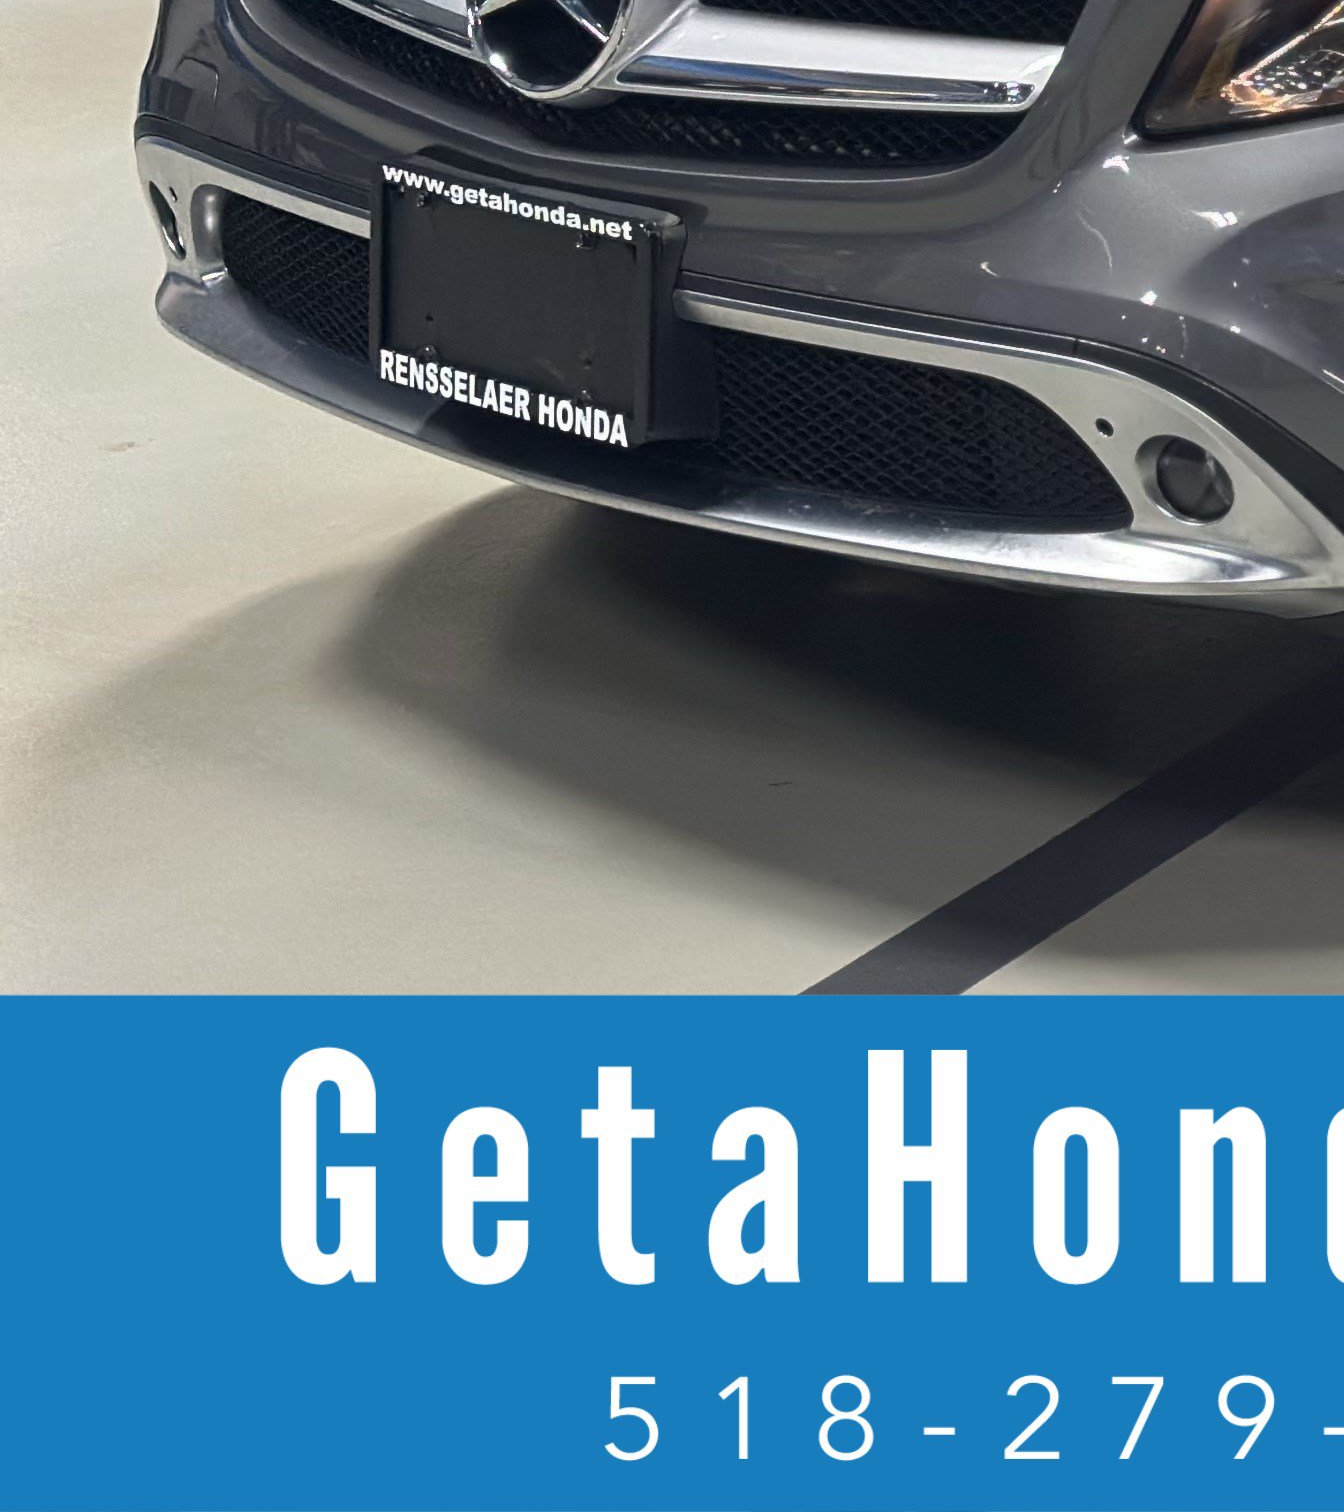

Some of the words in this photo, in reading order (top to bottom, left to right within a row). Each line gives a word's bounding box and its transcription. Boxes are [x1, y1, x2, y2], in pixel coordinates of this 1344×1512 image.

[381, 164, 634, 241] www.getahonda.net
[379, 348, 531, 421] RENSSELAER
[538, 393, 629, 448] HONDA
